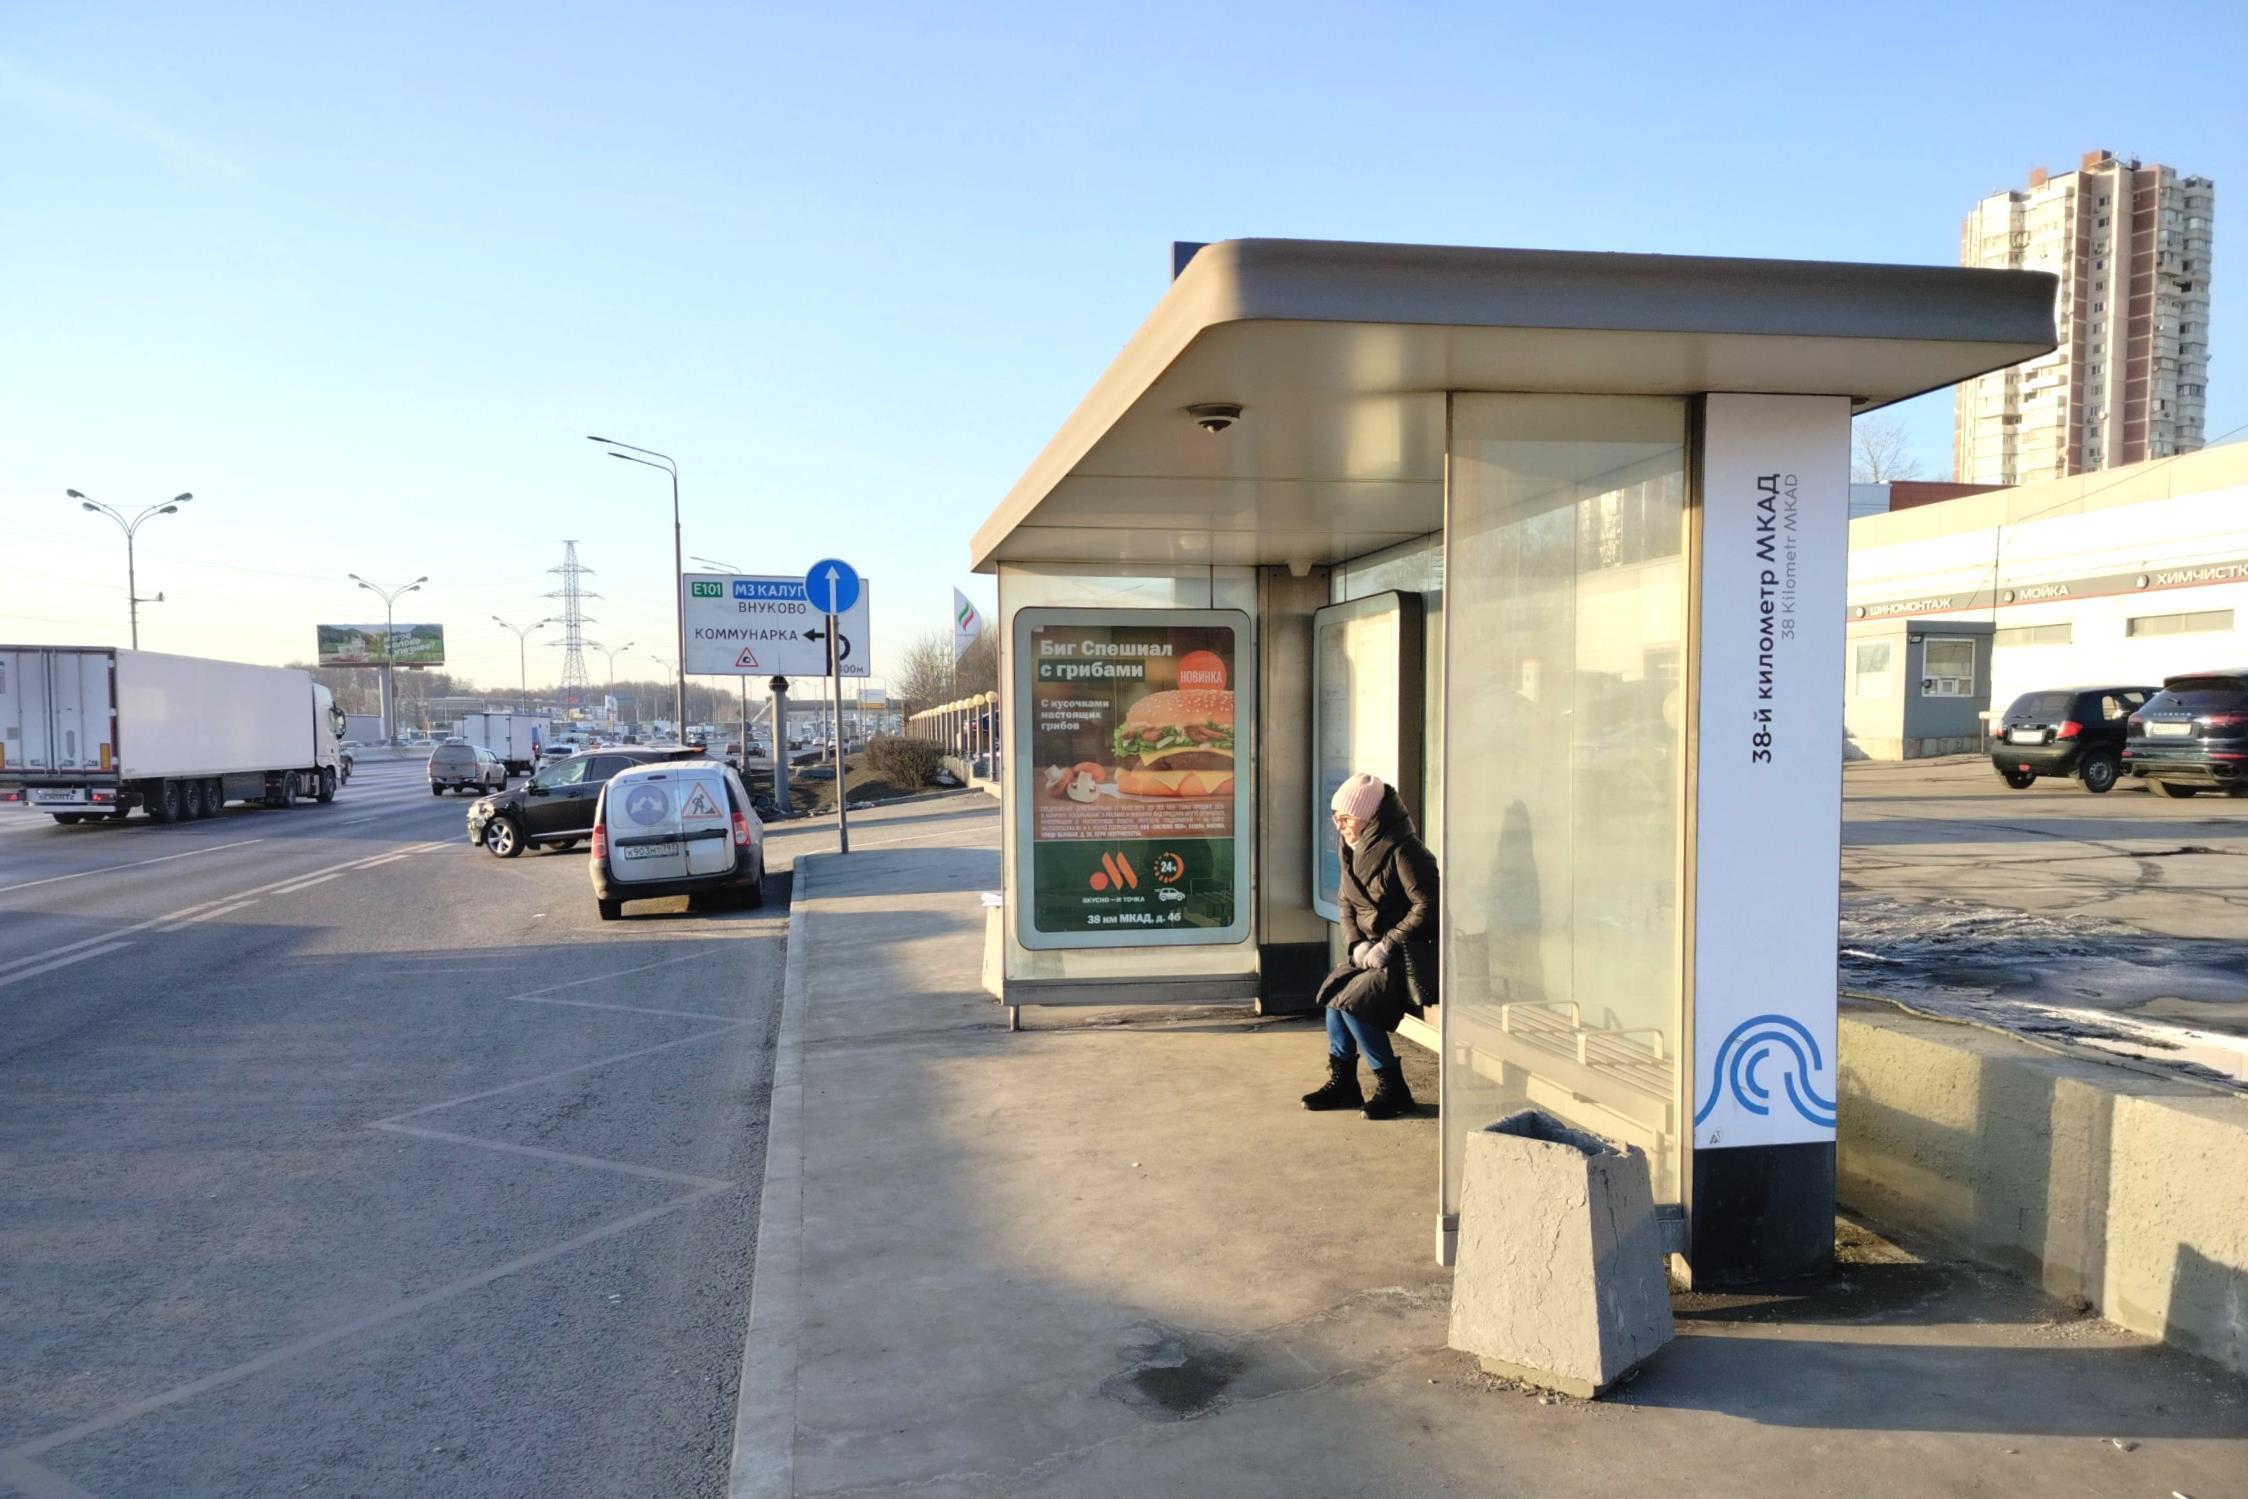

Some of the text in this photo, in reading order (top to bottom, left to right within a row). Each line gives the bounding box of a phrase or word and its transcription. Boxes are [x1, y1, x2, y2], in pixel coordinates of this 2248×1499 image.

[1781, 473, 1798, 640] 38 Kilometr MKAD
[693, 583, 722, 596] E101
[758, 585, 805, 598] КАЛУГ
[2019, 585, 2070, 601] МОЙКА
[738, 602, 806, 615] ВНУКОВО
[1870, 598, 1953, 616] ШИНОМОНТАЖ
[1752, 473, 1780, 764] 38-й километр МКАД
[695, 628, 798, 641] КОММУНАРКА
[1040, 640, 1173, 657] Биг Спешиал
[1040, 661, 1143, 681] с грибами
[1180, 671, 1223, 684] НОВИНКА
[1041, 699, 1110, 710] С кусочками
[1041, 711, 1102, 721] настоящих
[1041, 721, 1080, 732] грибов
[1087, 914, 1101, 924] 38
[1102, 916, 1118, 924] км
[1120, 914, 1154, 924] МКАД,
